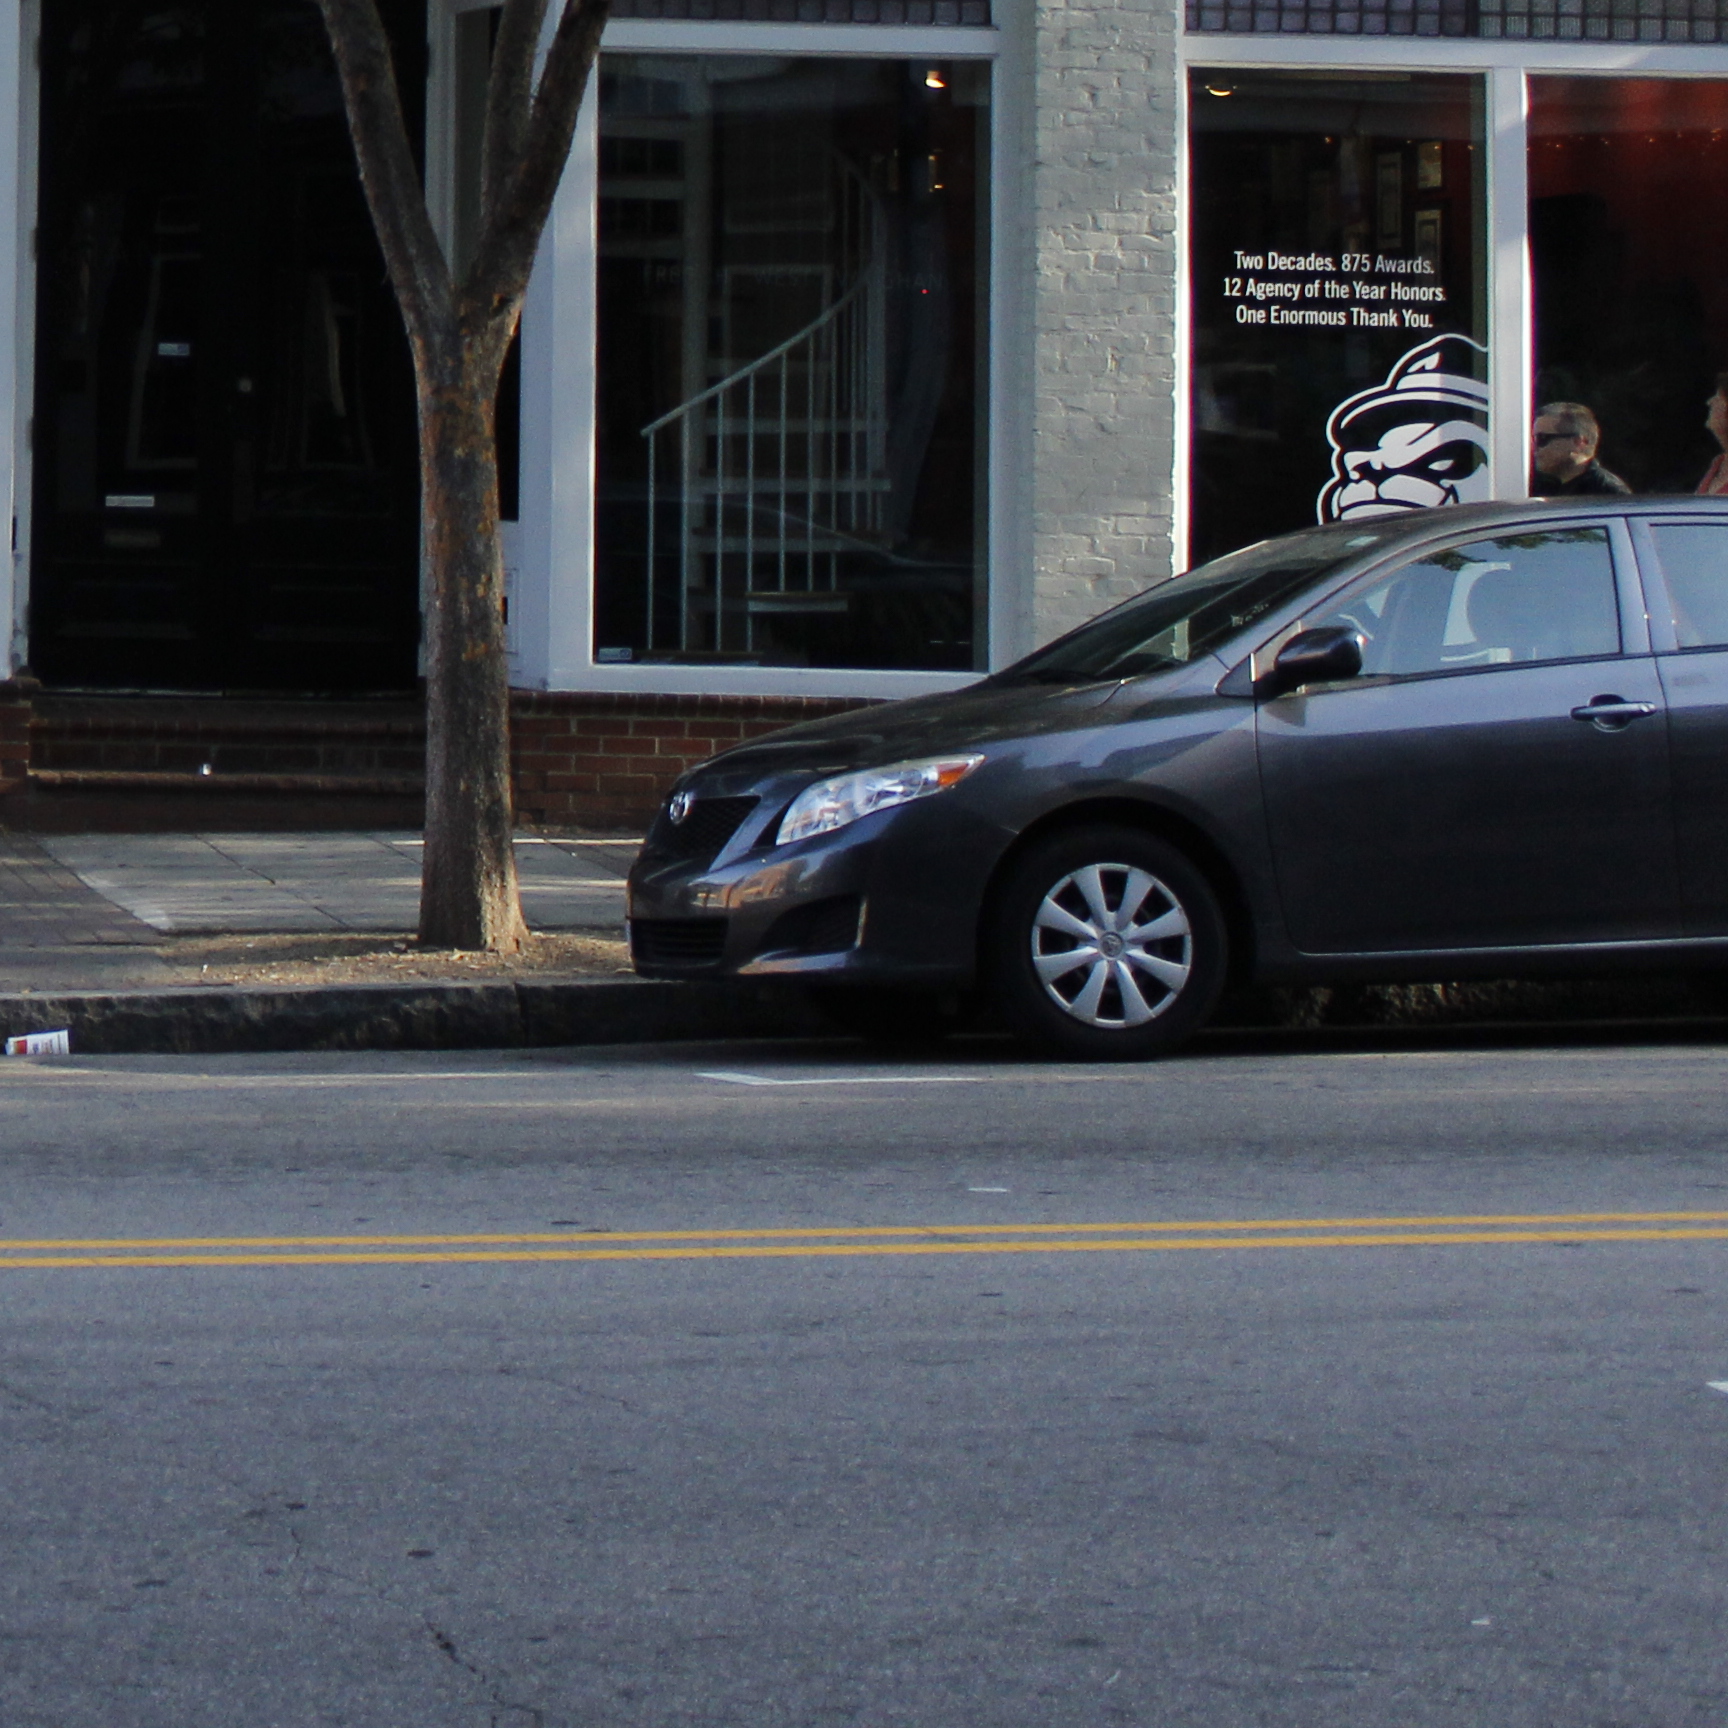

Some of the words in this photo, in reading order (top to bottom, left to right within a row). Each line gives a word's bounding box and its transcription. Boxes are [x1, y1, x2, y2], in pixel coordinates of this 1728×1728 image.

[1234, 251, 1264, 271] Two
[1268, 251, 1337, 272] Decades.
[1341, 253, 1372, 273] 875
[1374, 255, 1435, 274] Awards.
[1223, 277, 1242, 297] 12
[1245, 278, 1301, 301] Agency
[1304, 279, 1322, 298] of
[1324, 280, 1350, 299] the
[1352, 281, 1386, 300] Year
[1390, 282, 1447, 301] Honors.
[1236, 305, 1266, 324] One
[1270, 305, 1346, 326] Enormous
[1350, 307, 1398, 328] Thank
[1401, 309, 1434, 328] You.
